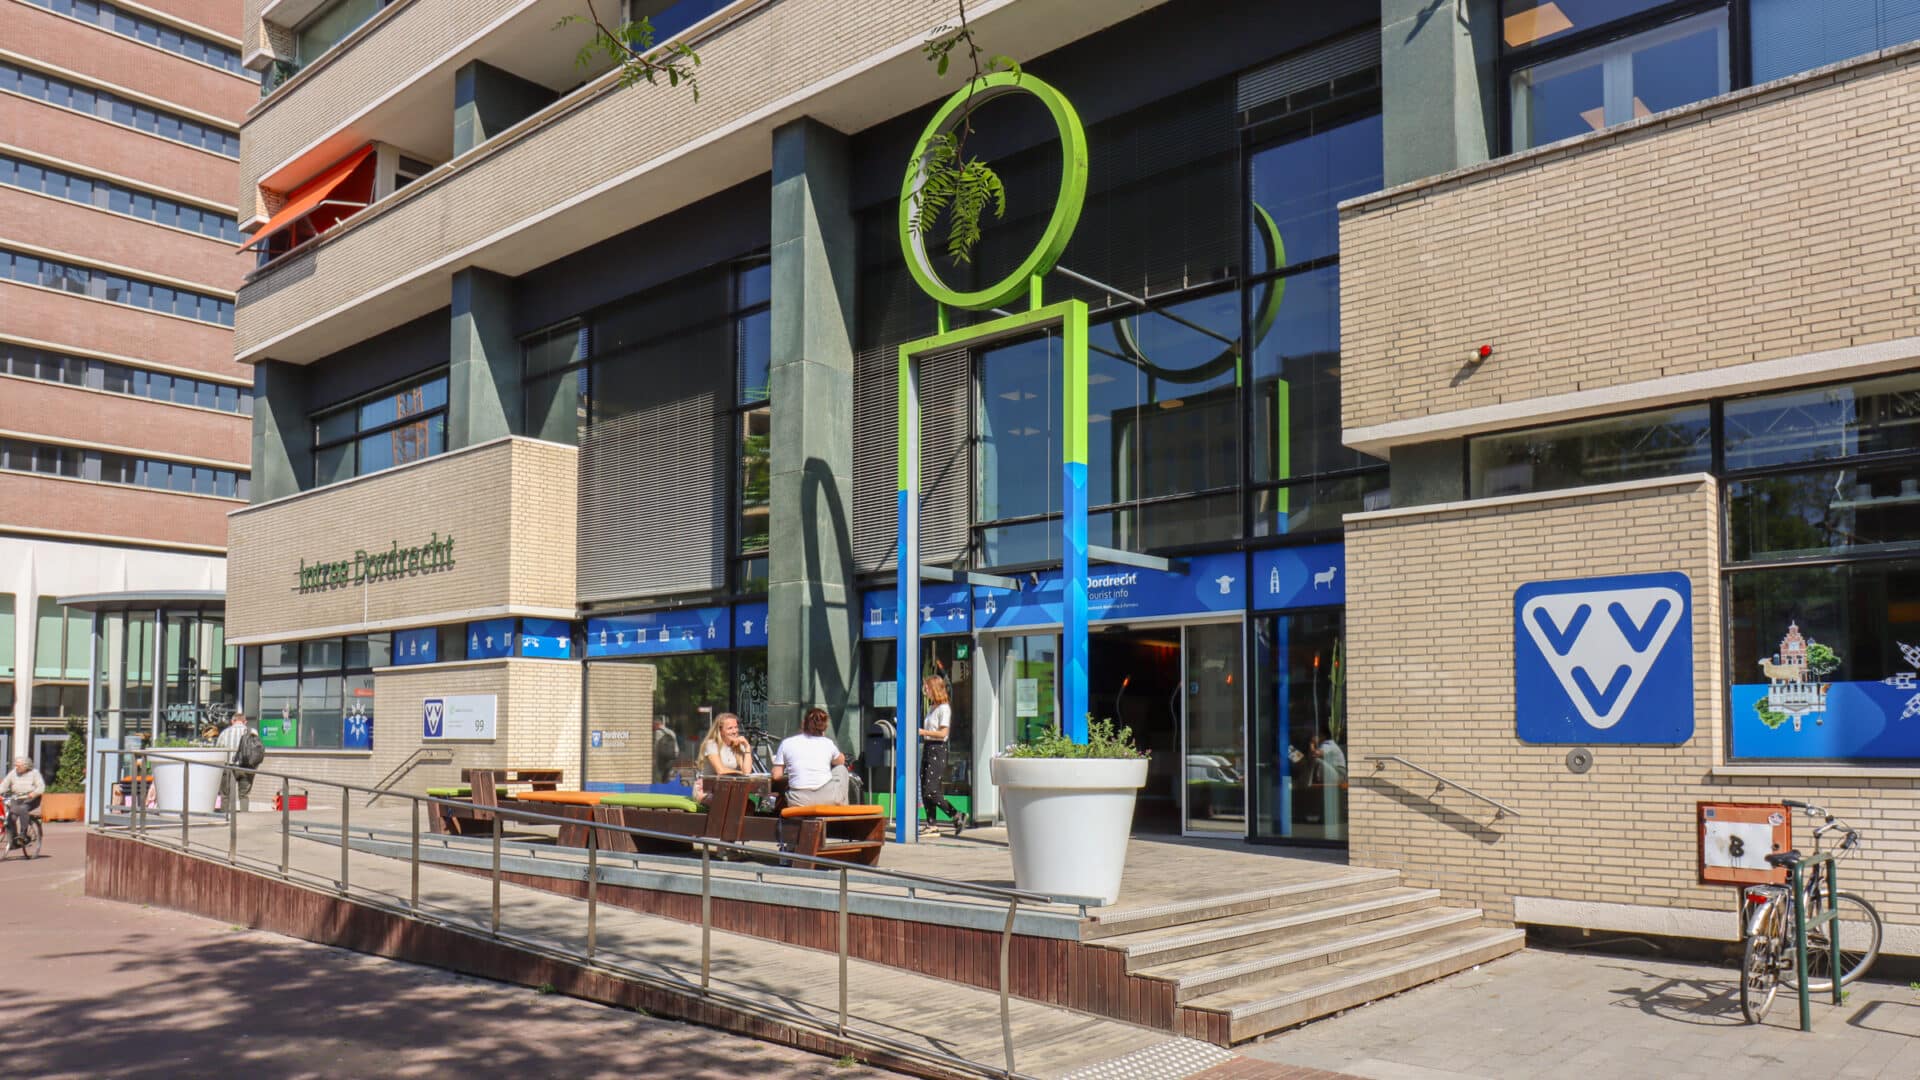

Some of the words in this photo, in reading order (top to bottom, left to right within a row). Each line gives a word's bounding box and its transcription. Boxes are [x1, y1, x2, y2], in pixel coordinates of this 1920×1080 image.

[300, 557, 349, 588] Intree
[355, 532, 456, 579] Dordrecht
[475, 719, 485, 732] 99
